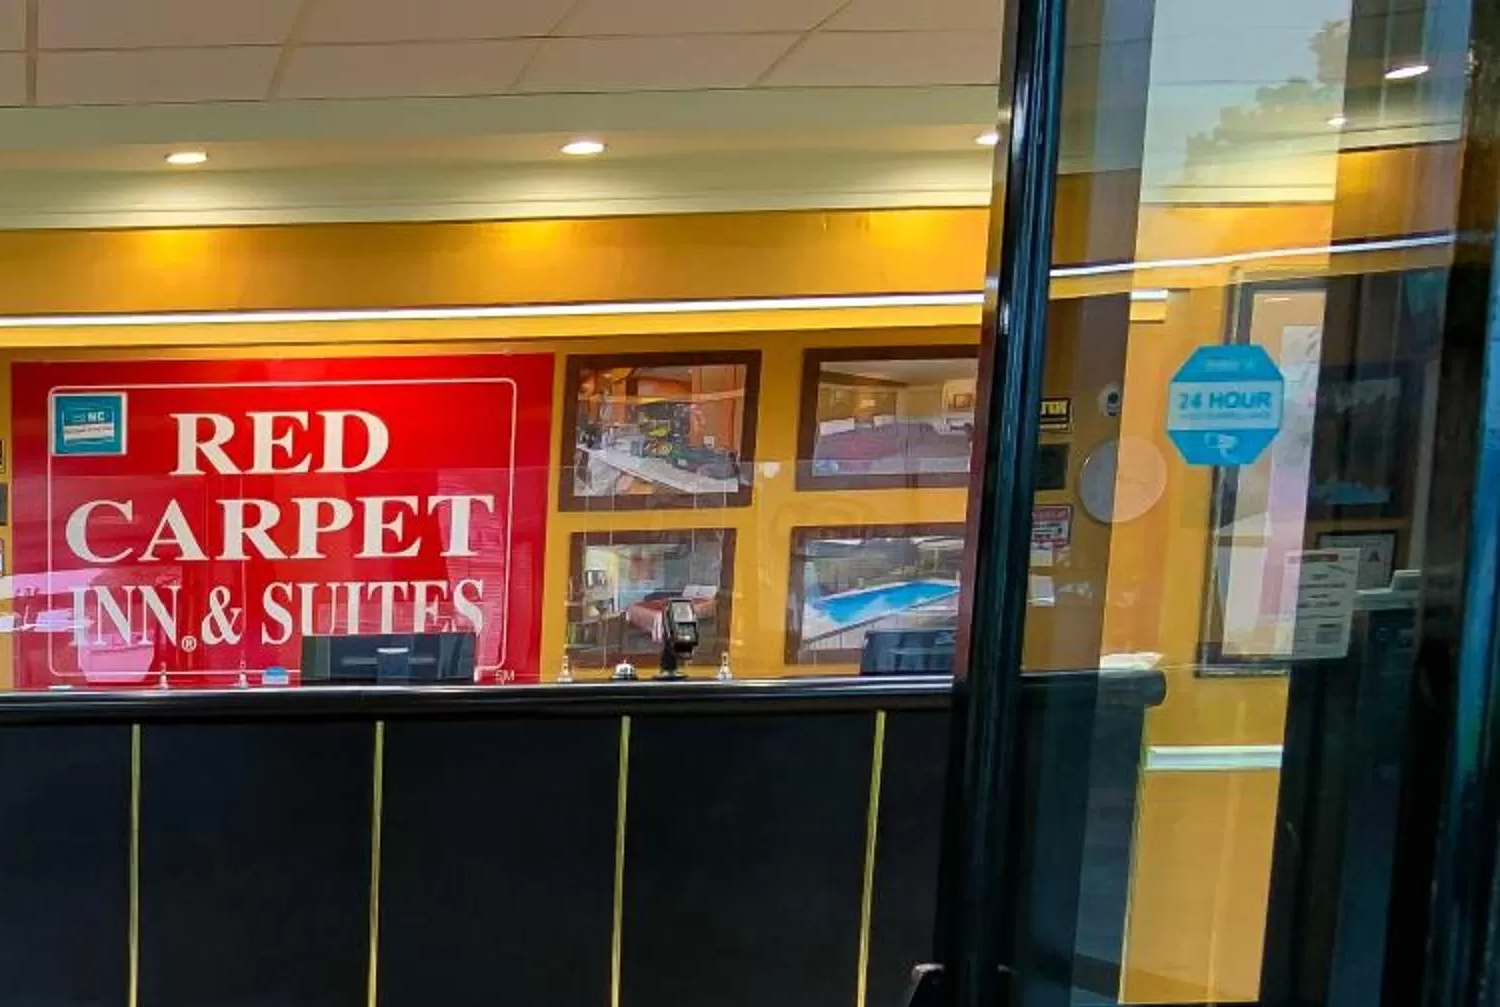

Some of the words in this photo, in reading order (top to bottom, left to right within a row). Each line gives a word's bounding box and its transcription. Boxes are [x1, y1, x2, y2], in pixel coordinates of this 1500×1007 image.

[1208, 390, 1271, 410] HOUR
[169, 410, 390, 476] RED
[65, 494, 495, 563] CARPET
[201, 585, 243, 645] &
[262, 579, 485, 645] SUITES
